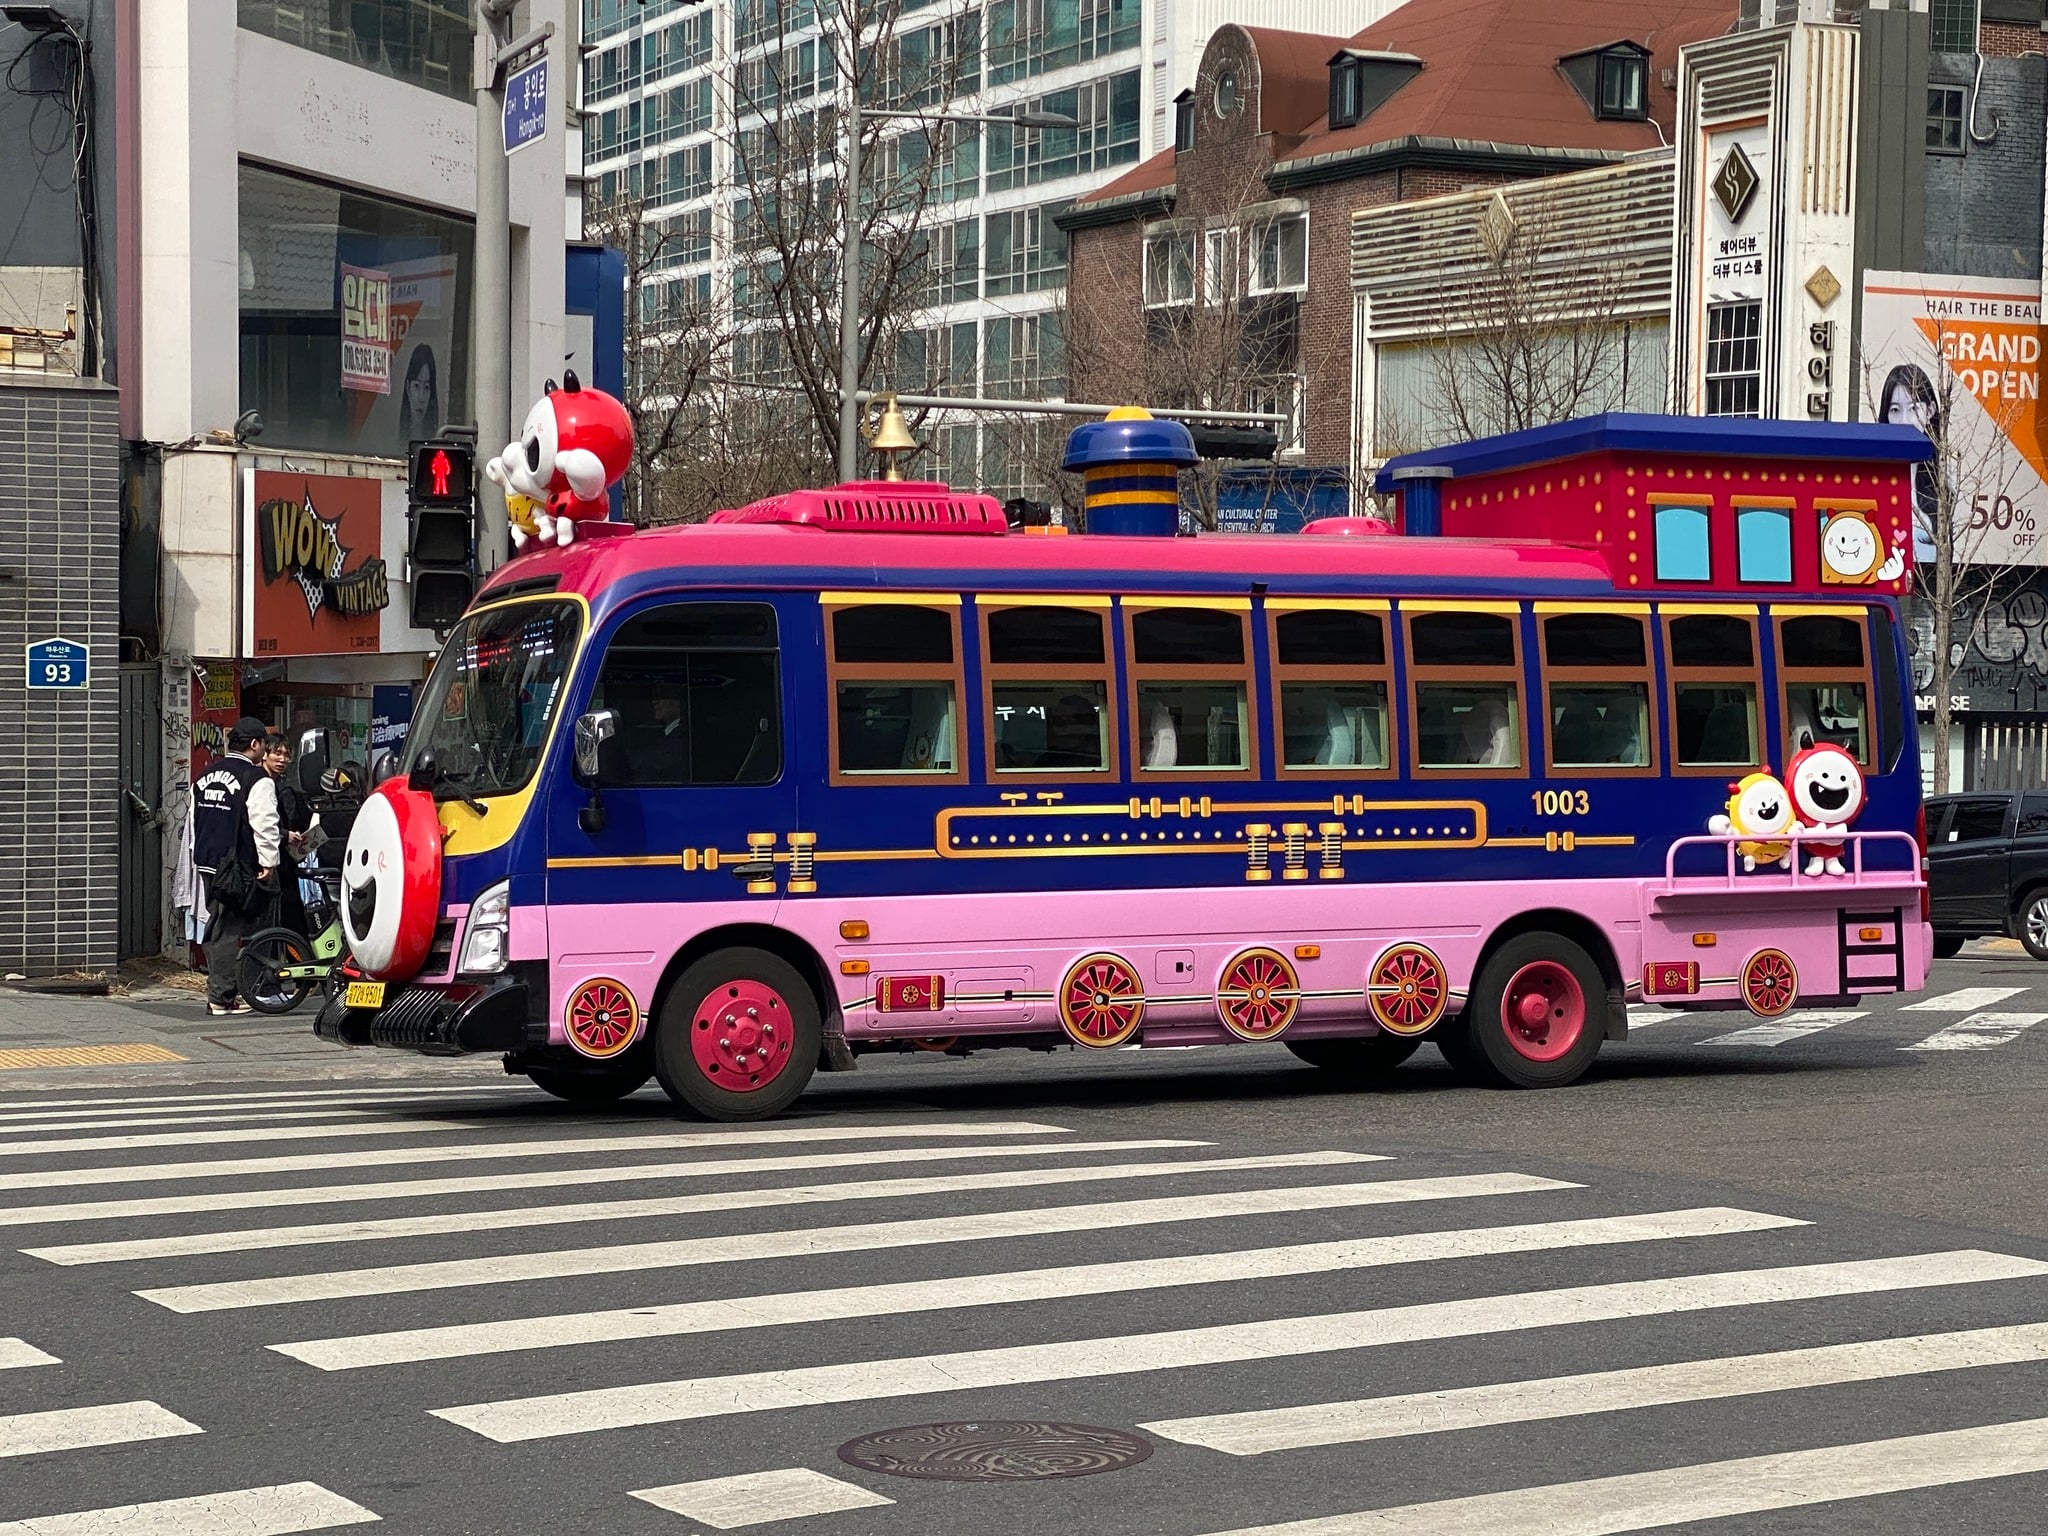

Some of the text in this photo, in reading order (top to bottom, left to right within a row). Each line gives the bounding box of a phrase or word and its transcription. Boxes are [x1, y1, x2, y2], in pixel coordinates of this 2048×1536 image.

[524, 69, 545, 111] 홍익로
[1713, 262, 1731, 279] 더뷰
[1733, 261, 1742, 278] 디
[343, 273, 388, 342] 임대
[1926, 300, 1963, 315] HAIR
[1970, 302, 1998, 316] THE
[1937, 331, 2041, 364] GRAND
[1959, 368, 2039, 400] OPEN
[1225, 508, 1254, 520] CULTURAL
[1970, 494, 2035, 531] 50%
[1224, 522, 1249, 533] CENTRAL
[2013, 533, 2035, 546] OFF
[272, 502, 339, 580] WOW
[336, 566, 388, 612] VINTAGE
[45, 664, 71, 682] 93
[192, 721, 218, 746] WOW
[196, 770, 241, 795] HONGIK
[1531, 790, 1590, 815] 1003
